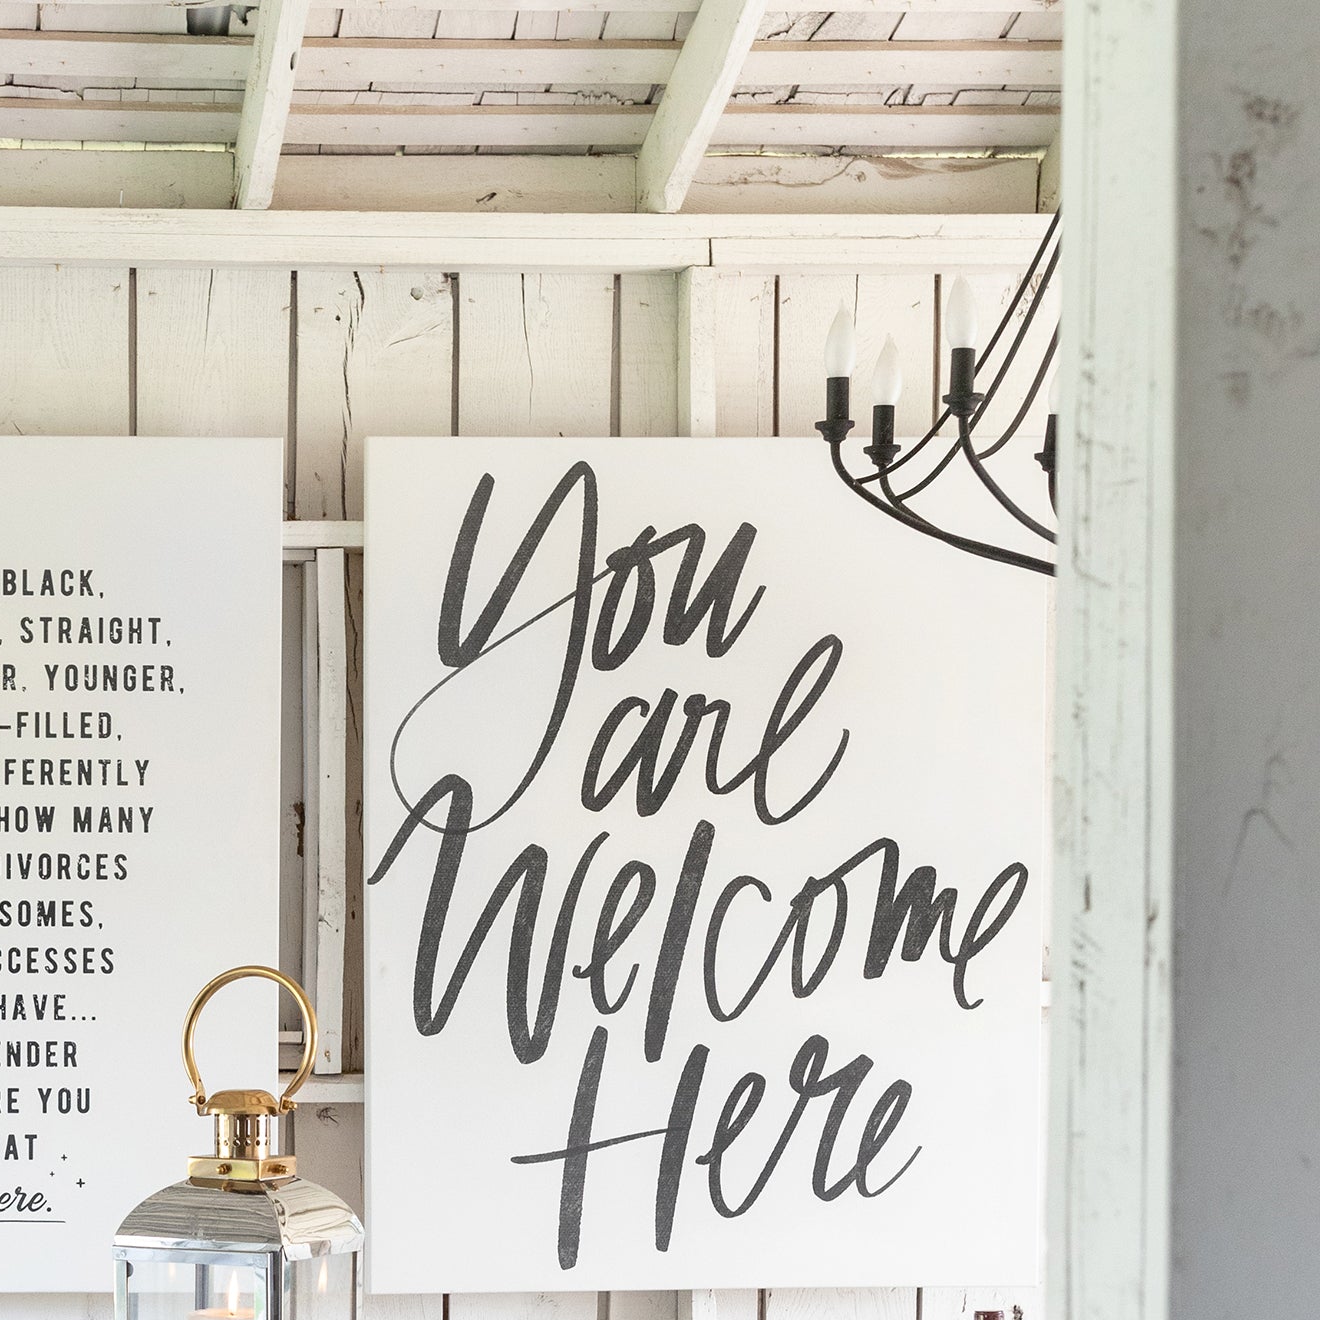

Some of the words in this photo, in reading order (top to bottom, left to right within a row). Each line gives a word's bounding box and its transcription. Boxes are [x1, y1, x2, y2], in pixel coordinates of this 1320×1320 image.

[2, 568, 104, 598] BLACK,
[20, 616, 171, 646] STRAIGHT,
[389, 461, 766, 834] You
[44, 664, 184, 693] YOUNGER,
[581, 634, 849, 825] are
[73, 806, 154, 834] MANY
[367, 774, 1030, 1064] Welcome
[37, 1087, 90, 1115] YOU
[510, 1026, 923, 1270] Here
